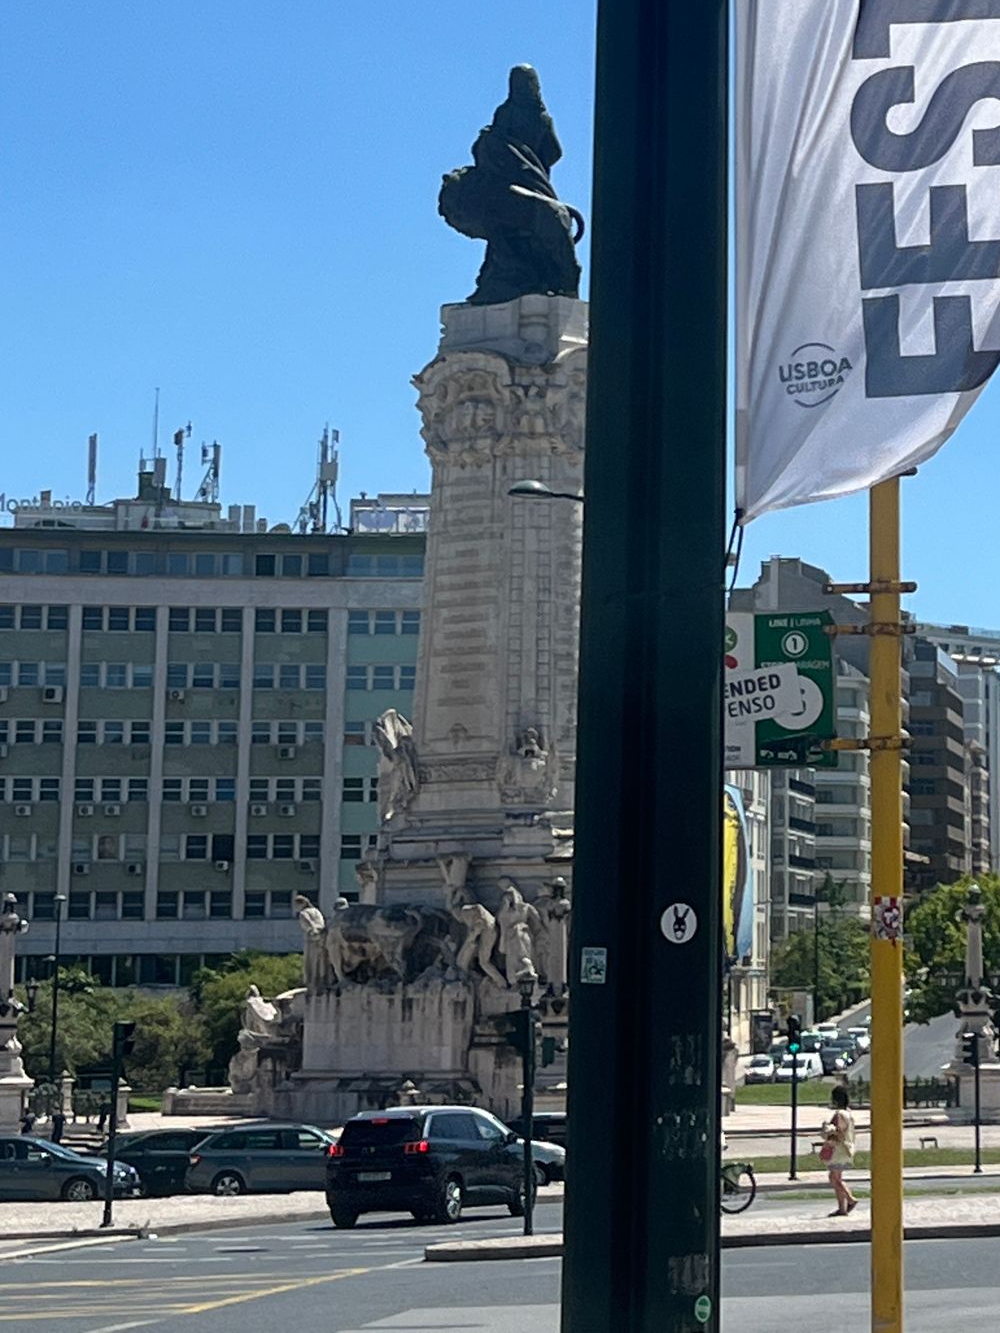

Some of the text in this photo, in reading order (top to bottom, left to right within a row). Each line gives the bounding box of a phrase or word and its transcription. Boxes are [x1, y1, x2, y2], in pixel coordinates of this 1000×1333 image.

[786, 374, 844, 395] CULTURA
[0, 492, 82, 515] ontpio
[728, 695, 775, 717] ENSO
